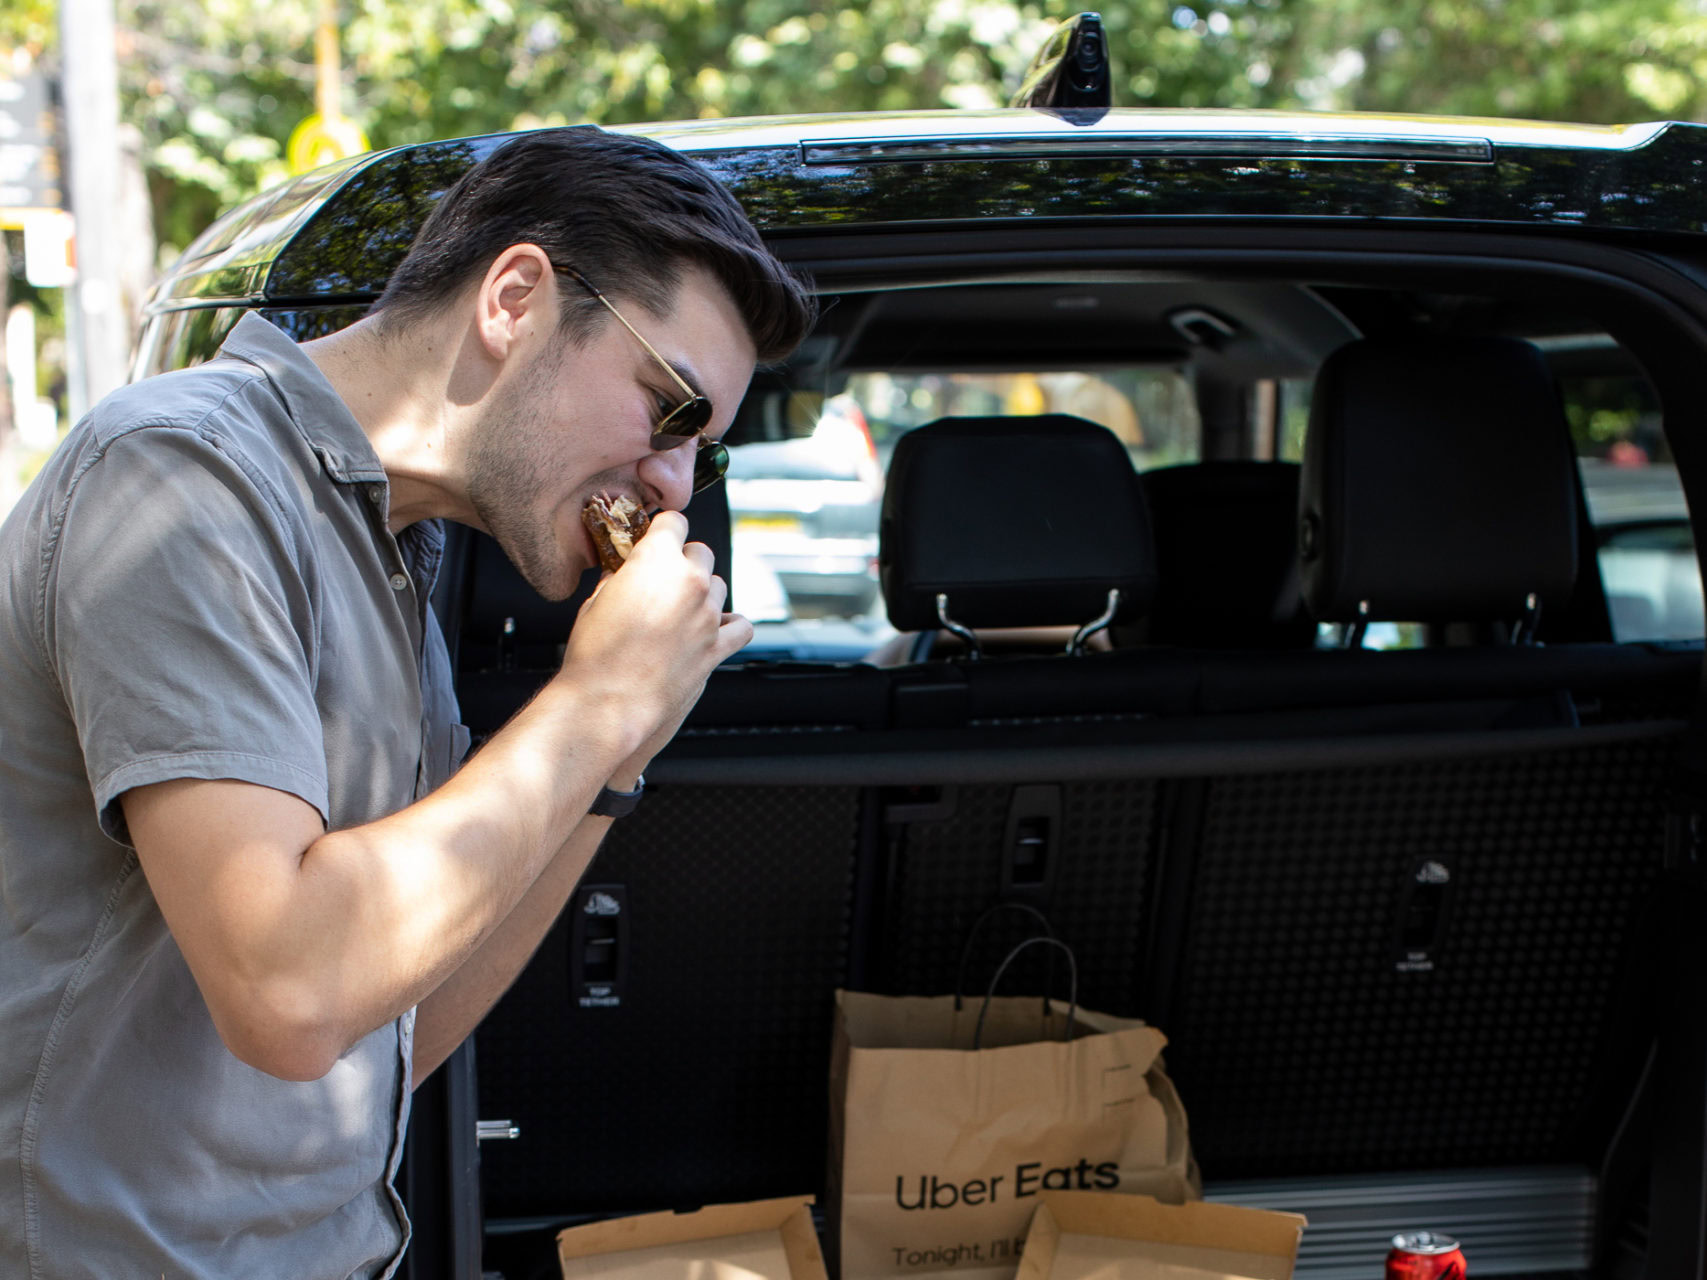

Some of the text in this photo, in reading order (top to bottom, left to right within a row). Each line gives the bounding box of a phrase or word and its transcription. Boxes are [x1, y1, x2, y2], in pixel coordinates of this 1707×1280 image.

[896, 1158, 1120, 1211] Uber Eats
[892, 1242, 985, 1266] Tonight,
